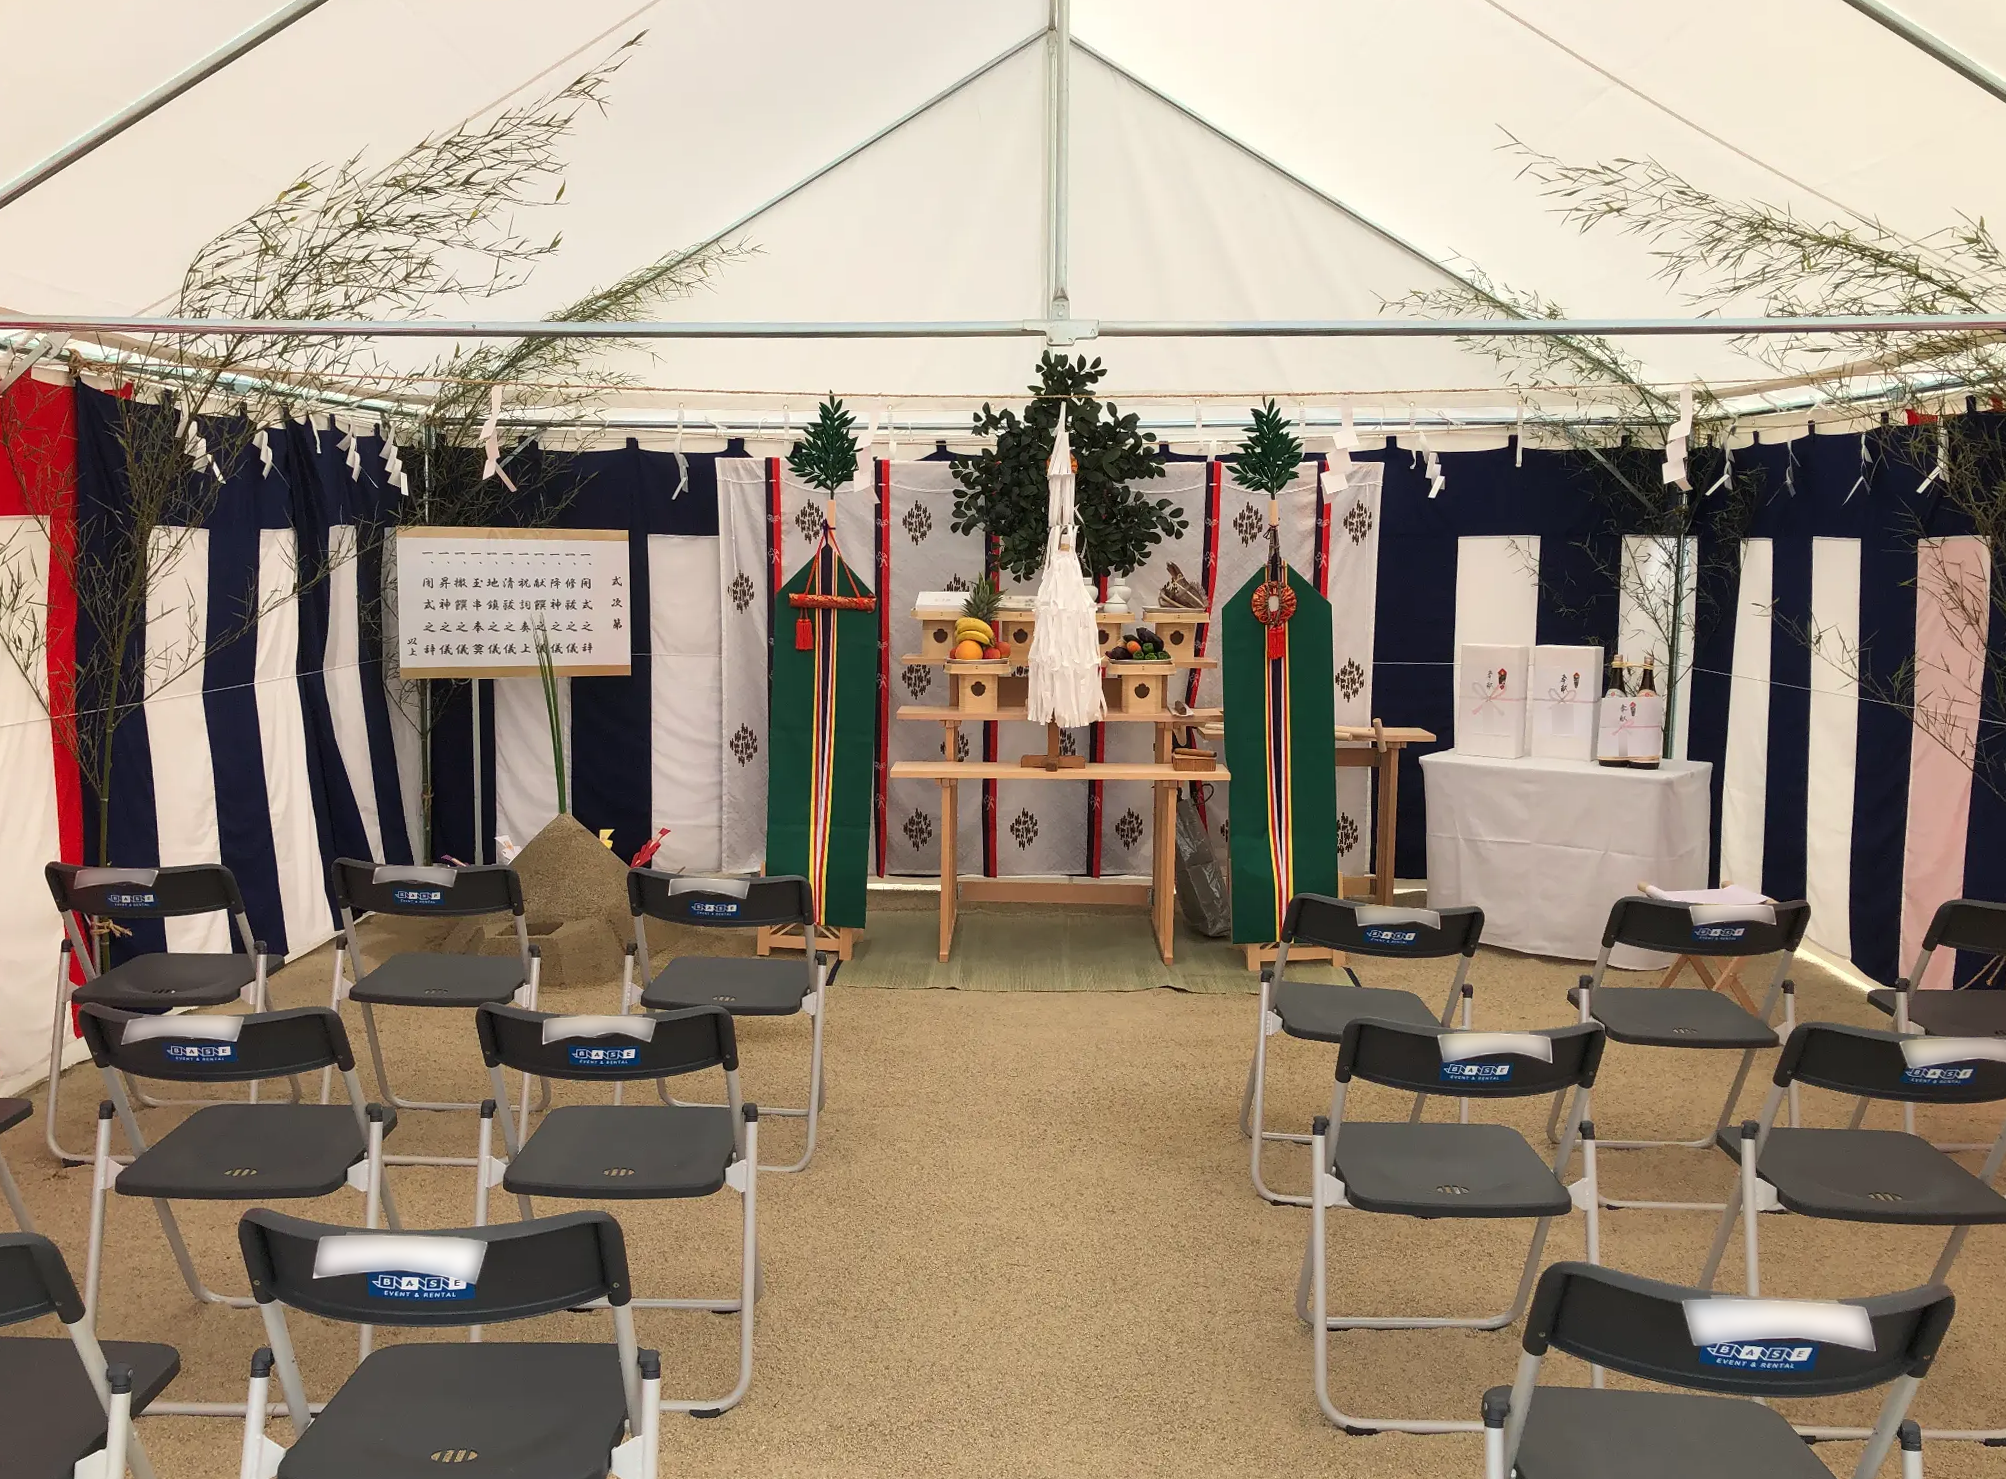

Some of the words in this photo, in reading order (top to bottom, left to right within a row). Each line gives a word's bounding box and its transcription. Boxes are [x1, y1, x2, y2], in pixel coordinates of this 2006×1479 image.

[611, 575, 623, 631] 式次第
[407, 637, 418, 657] 以上
[170, 1046, 231, 1057] BASE
[576, 1049, 636, 1059] BASE
[1449, 1064, 1509, 1075] BASE
[1911, 1068, 1973, 1079] BASE
[379, 1275, 467, 1291] BASE
[1714, 1343, 1812, 1361] BASE
[1716, 1358, 1747, 1367] EVENT
